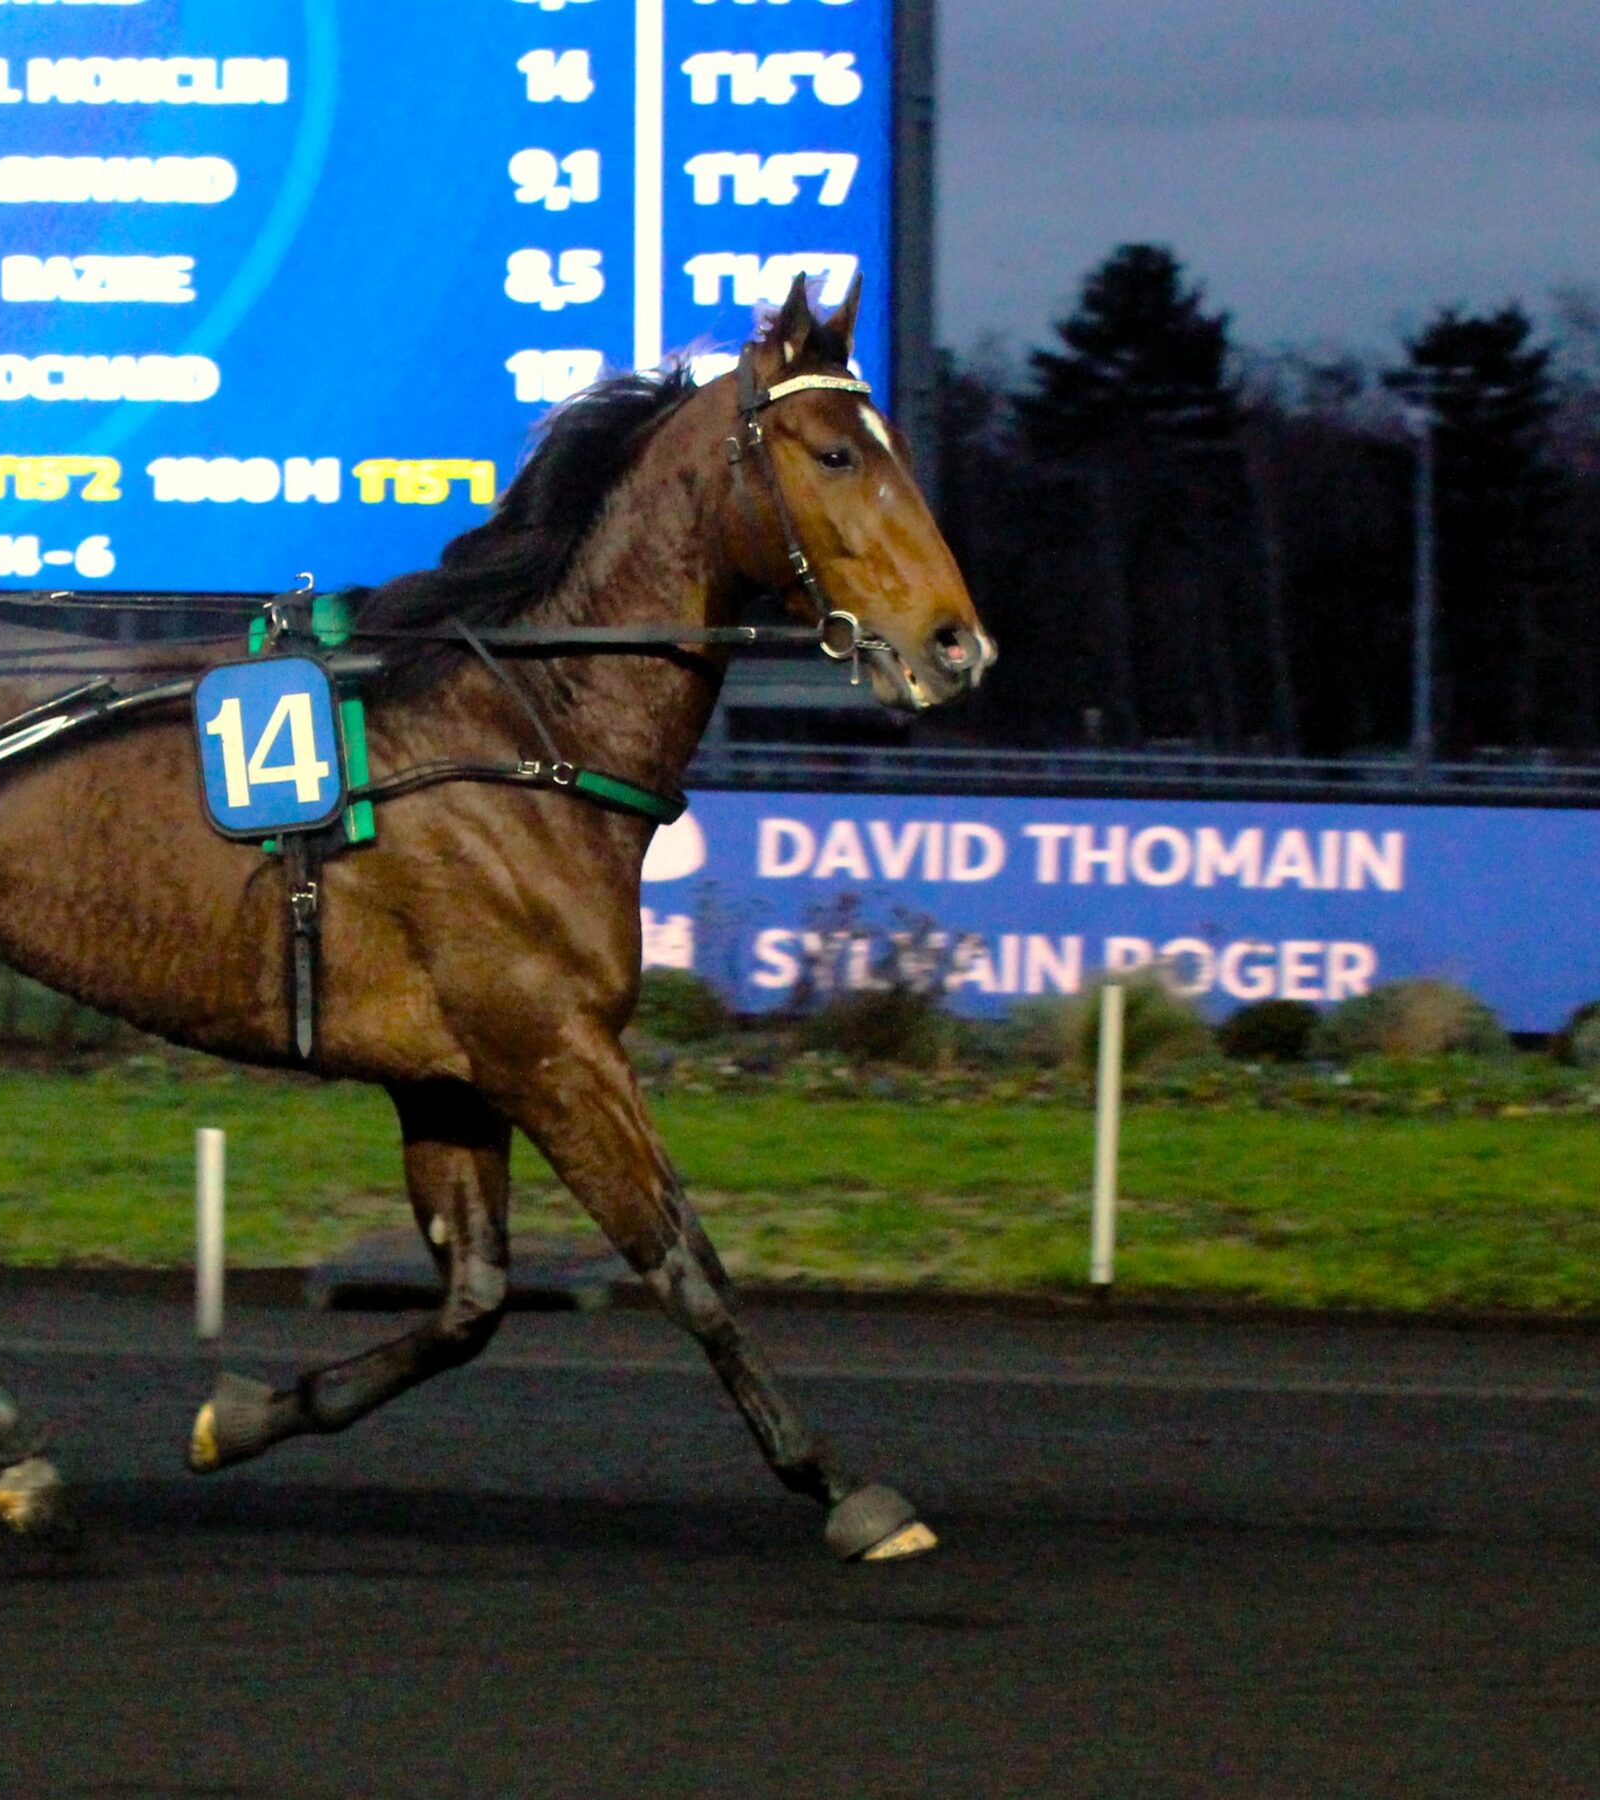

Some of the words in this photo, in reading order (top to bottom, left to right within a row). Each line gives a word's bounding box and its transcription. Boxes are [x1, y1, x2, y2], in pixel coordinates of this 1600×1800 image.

[517, 49, 594, 103] 14
[509, 149, 600, 211] 9,1
[505, 249, 604, 311] 8,5
[206, 693, 329, 807] 14
[756, 817, 1005, 882] DAVID
[1023, 823, 1404, 892] THOMAIN
